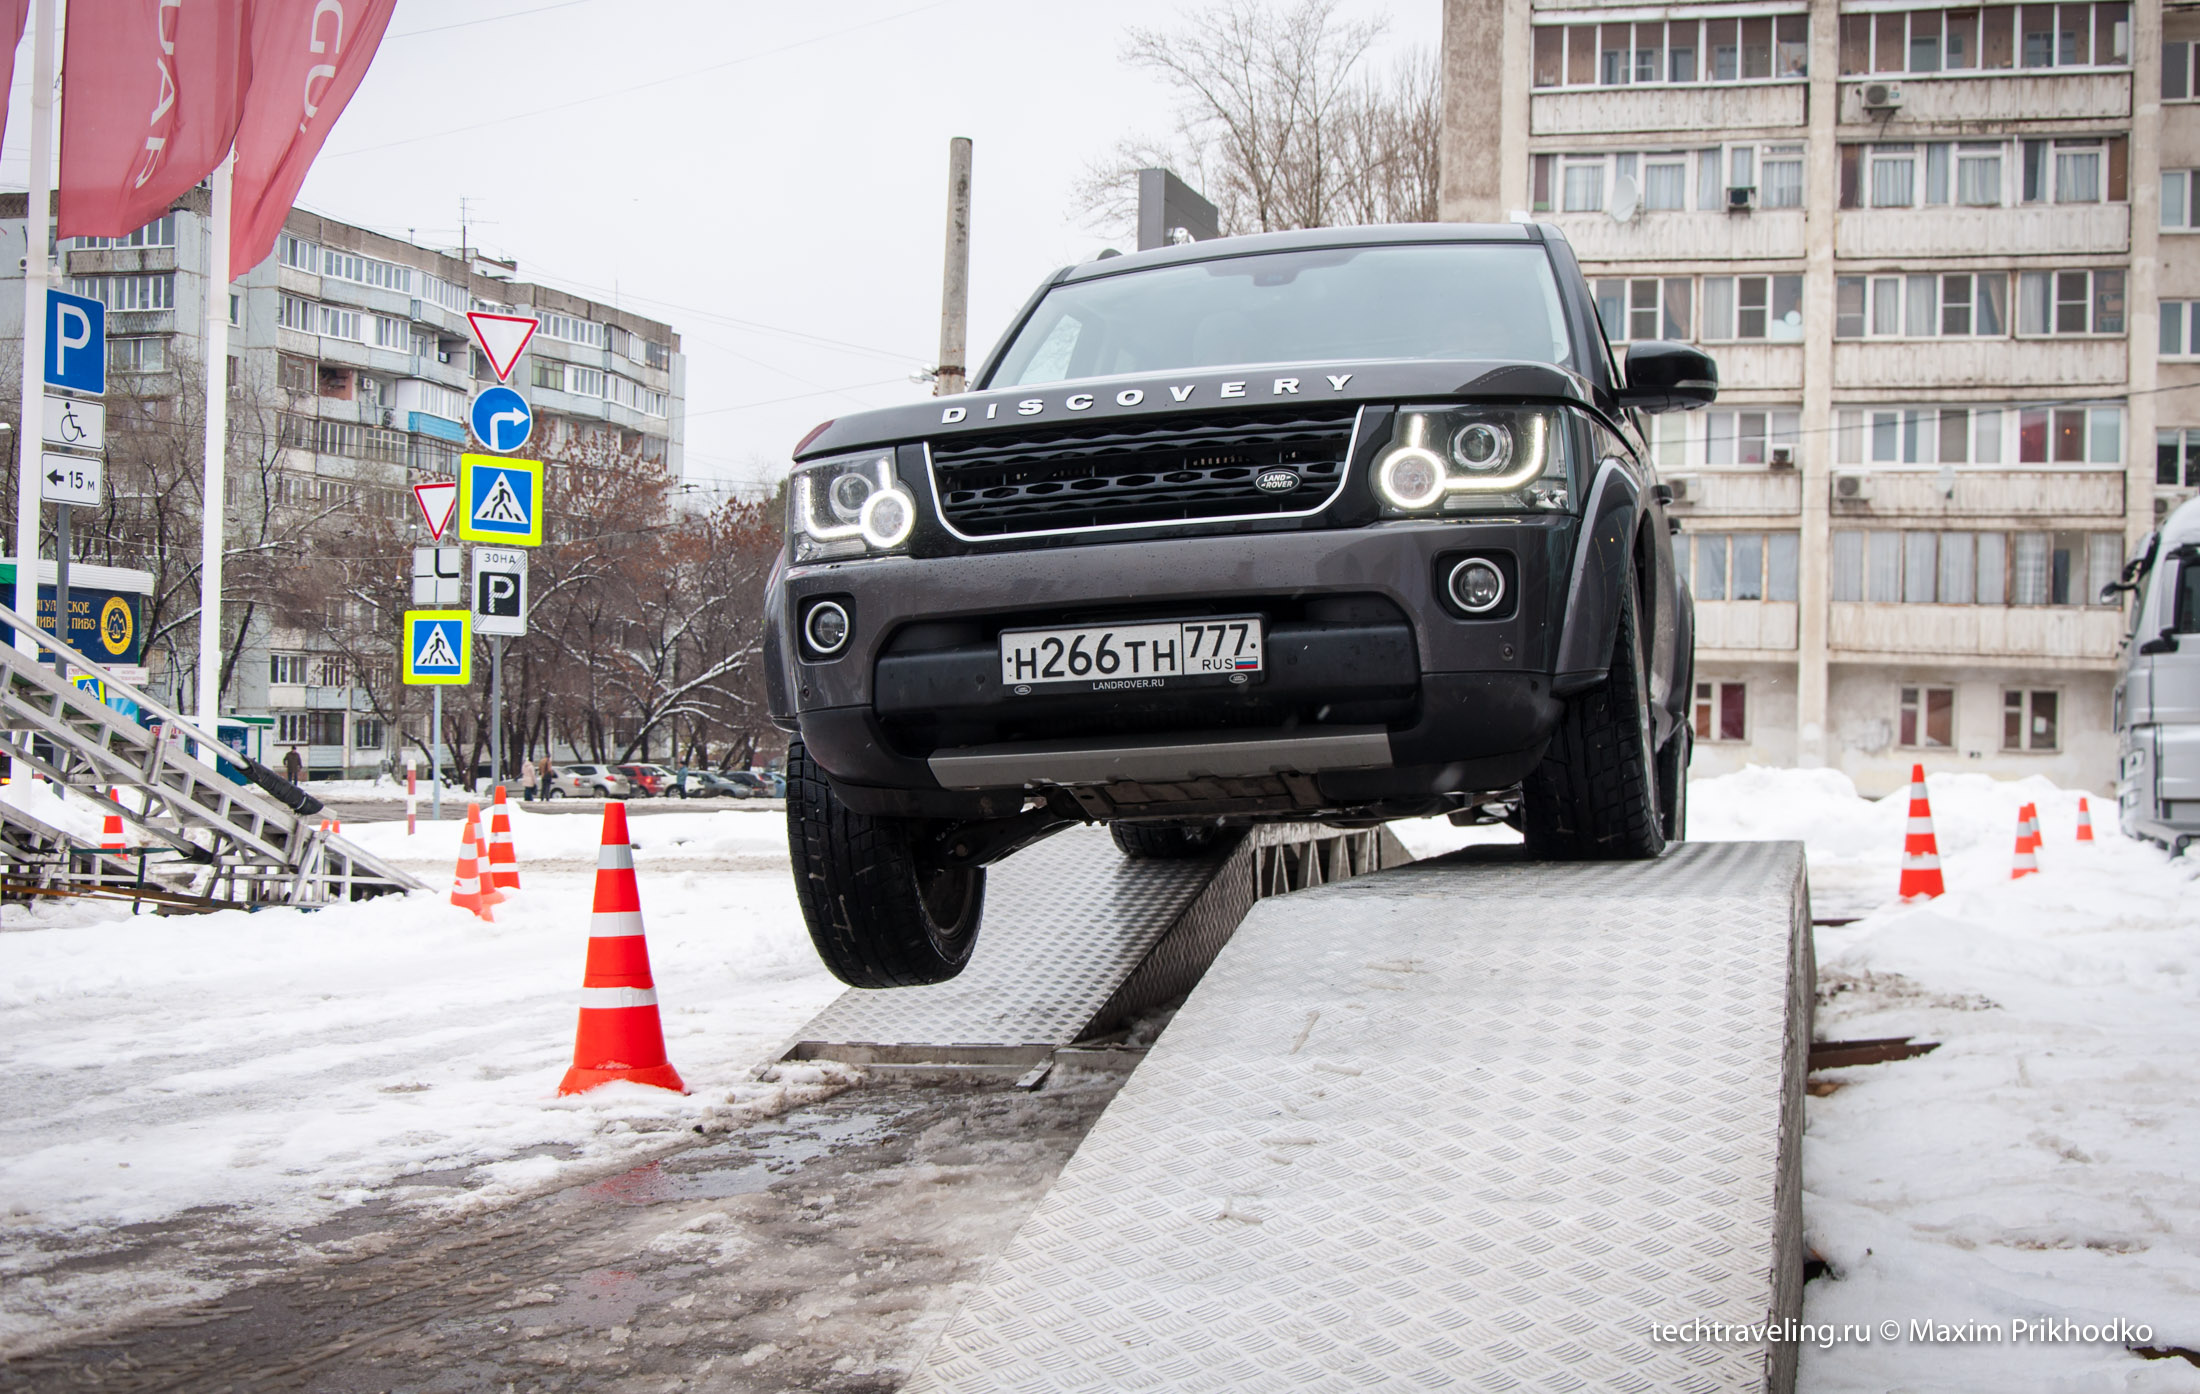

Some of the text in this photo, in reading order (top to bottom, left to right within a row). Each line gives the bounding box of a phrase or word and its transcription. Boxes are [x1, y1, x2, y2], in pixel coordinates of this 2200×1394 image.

[300, 0, 344, 133] GU
[56, 301, 91, 376] P
[941, 374, 1353, 425] DISCOVERY
[69, 470, 84, 489] 15
[1263, 474, 1286, 482] LAND
[1265, 481, 1293, 489] ROVER
[484, 552, 517, 565] ЗОНА
[488, 574, 515, 614] P
[71, 617, 97, 630] ПИВО
[1185, 623, 1249, 658] 777
[1202, 658, 1234, 671] RUS
[1092, 678, 1165, 691] LANDROVER.RU
